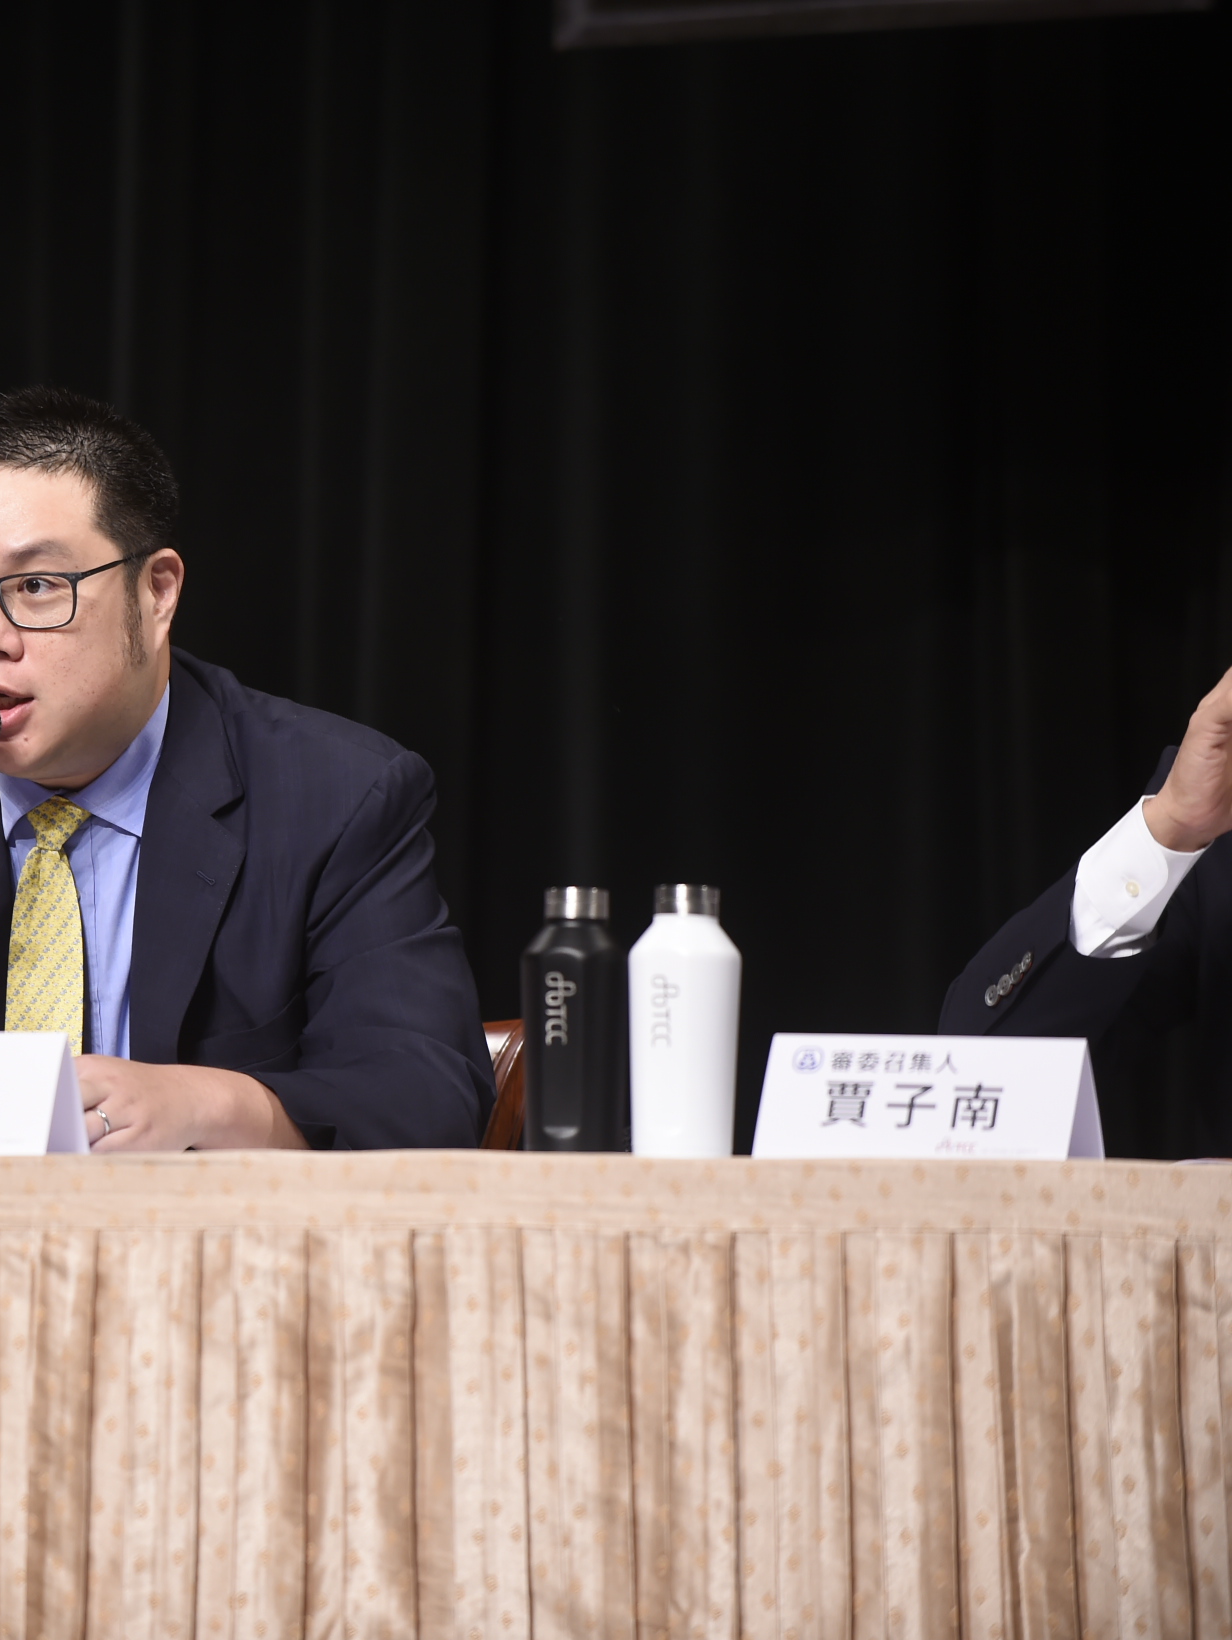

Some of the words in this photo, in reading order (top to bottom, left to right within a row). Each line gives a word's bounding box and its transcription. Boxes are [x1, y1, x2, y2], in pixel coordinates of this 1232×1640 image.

[831, 1050, 959, 1075] 審委召集人
[821, 1080, 1004, 1131] 賈子南
